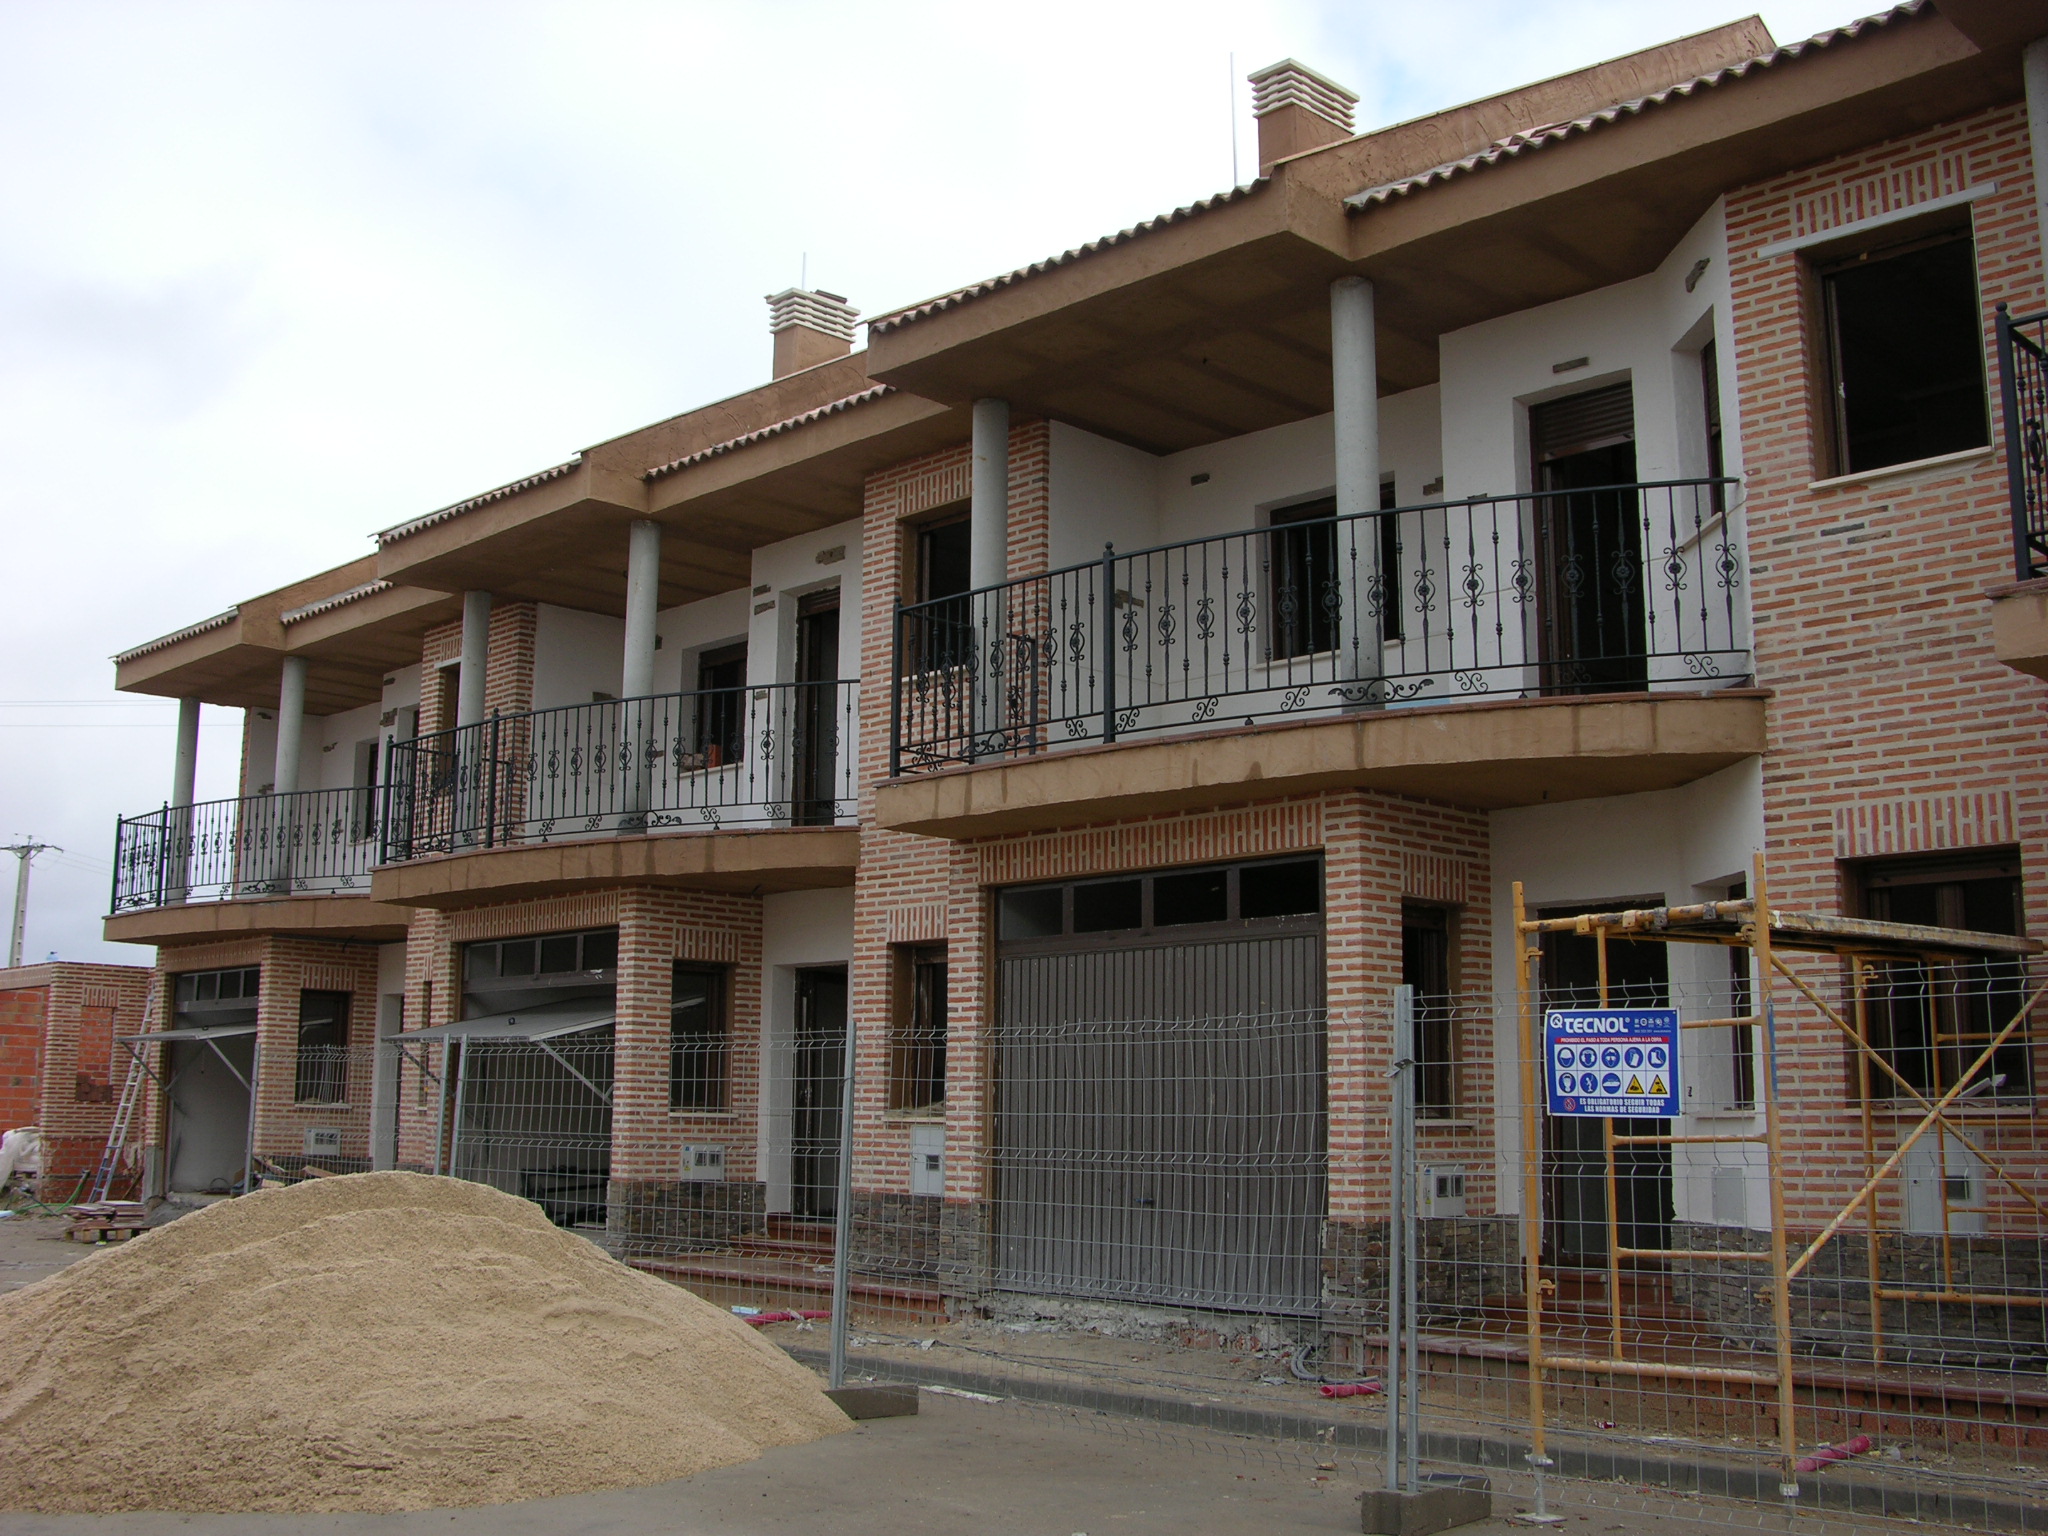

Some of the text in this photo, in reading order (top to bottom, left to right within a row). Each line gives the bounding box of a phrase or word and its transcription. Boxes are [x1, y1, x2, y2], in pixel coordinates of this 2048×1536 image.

[1564, 1017, 1629, 1034] TECNOL
[1587, 1098, 1623, 1106] OBLIGATORIO
[1624, 1098, 1645, 1106] SEGUIR
[1595, 1105, 1619, 1113] NORMAS
